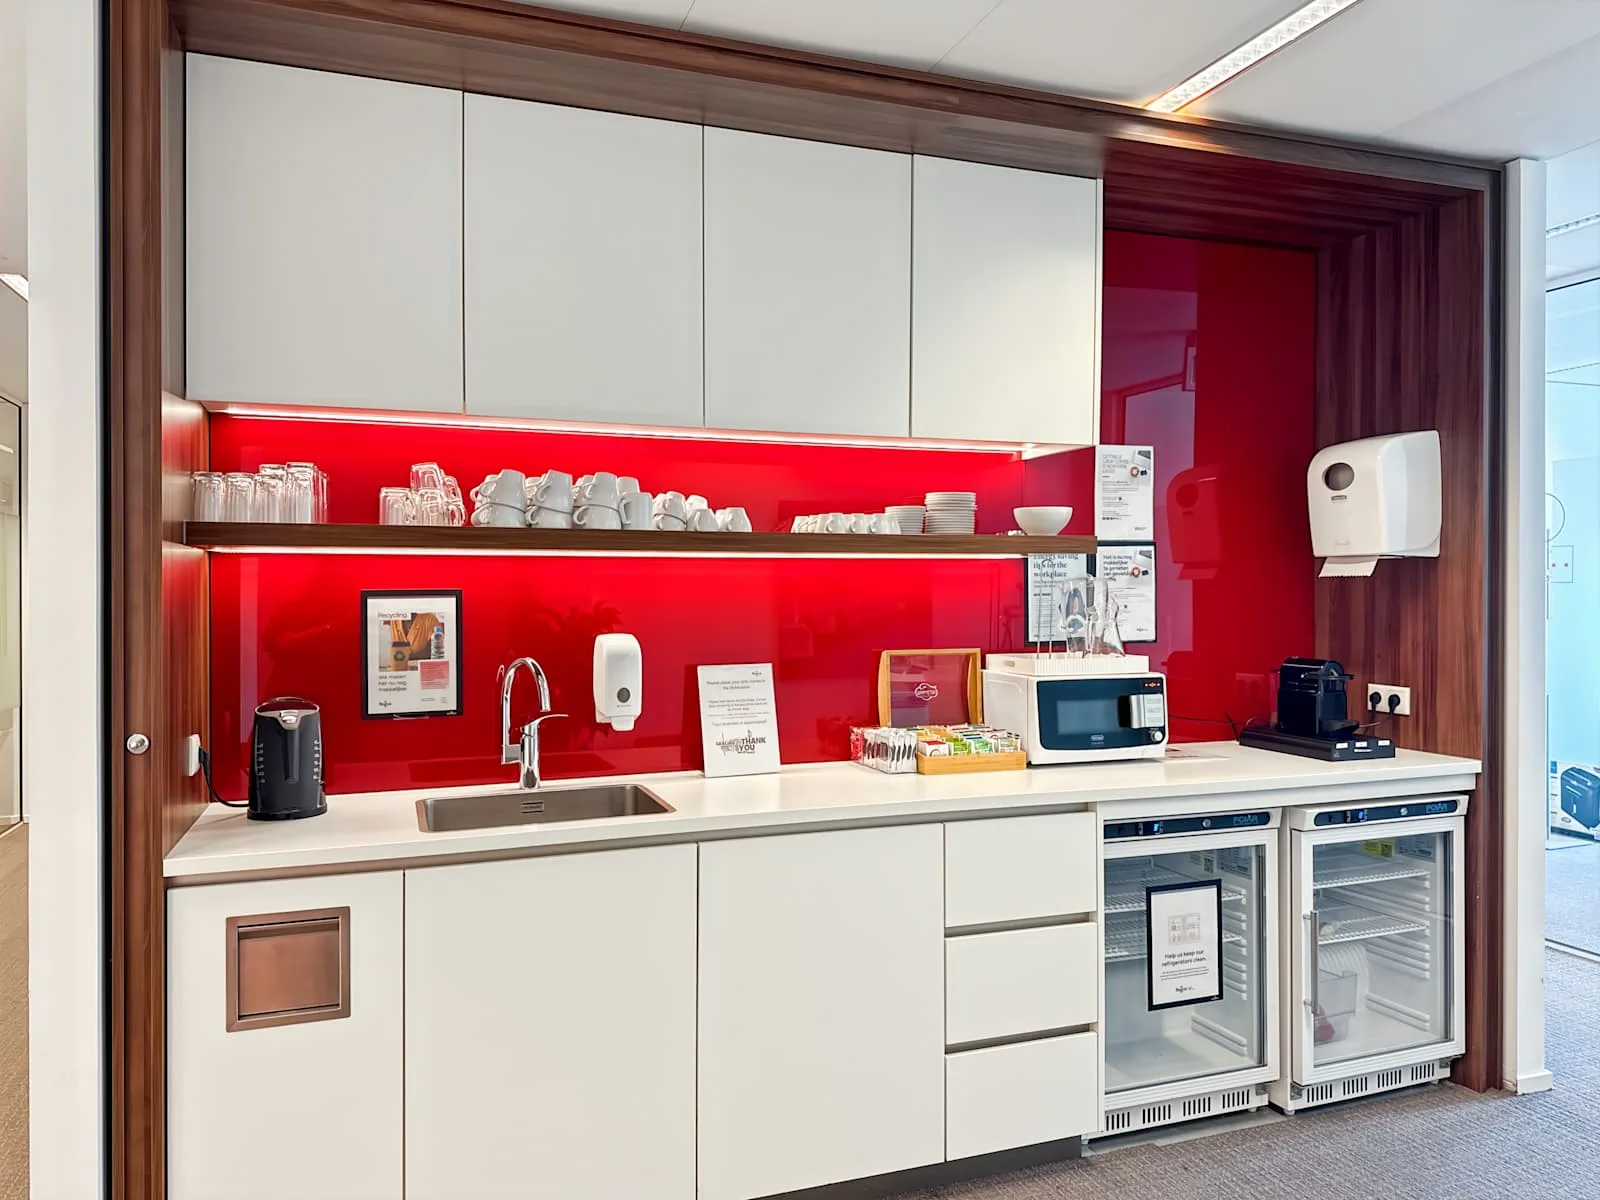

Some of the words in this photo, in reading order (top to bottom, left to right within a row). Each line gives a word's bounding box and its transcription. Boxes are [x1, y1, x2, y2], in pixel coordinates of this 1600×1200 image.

[741, 737, 766, 745] THANK
[739, 744, 755, 752] YOU
[1233, 815, 1259, 825] POLAR
